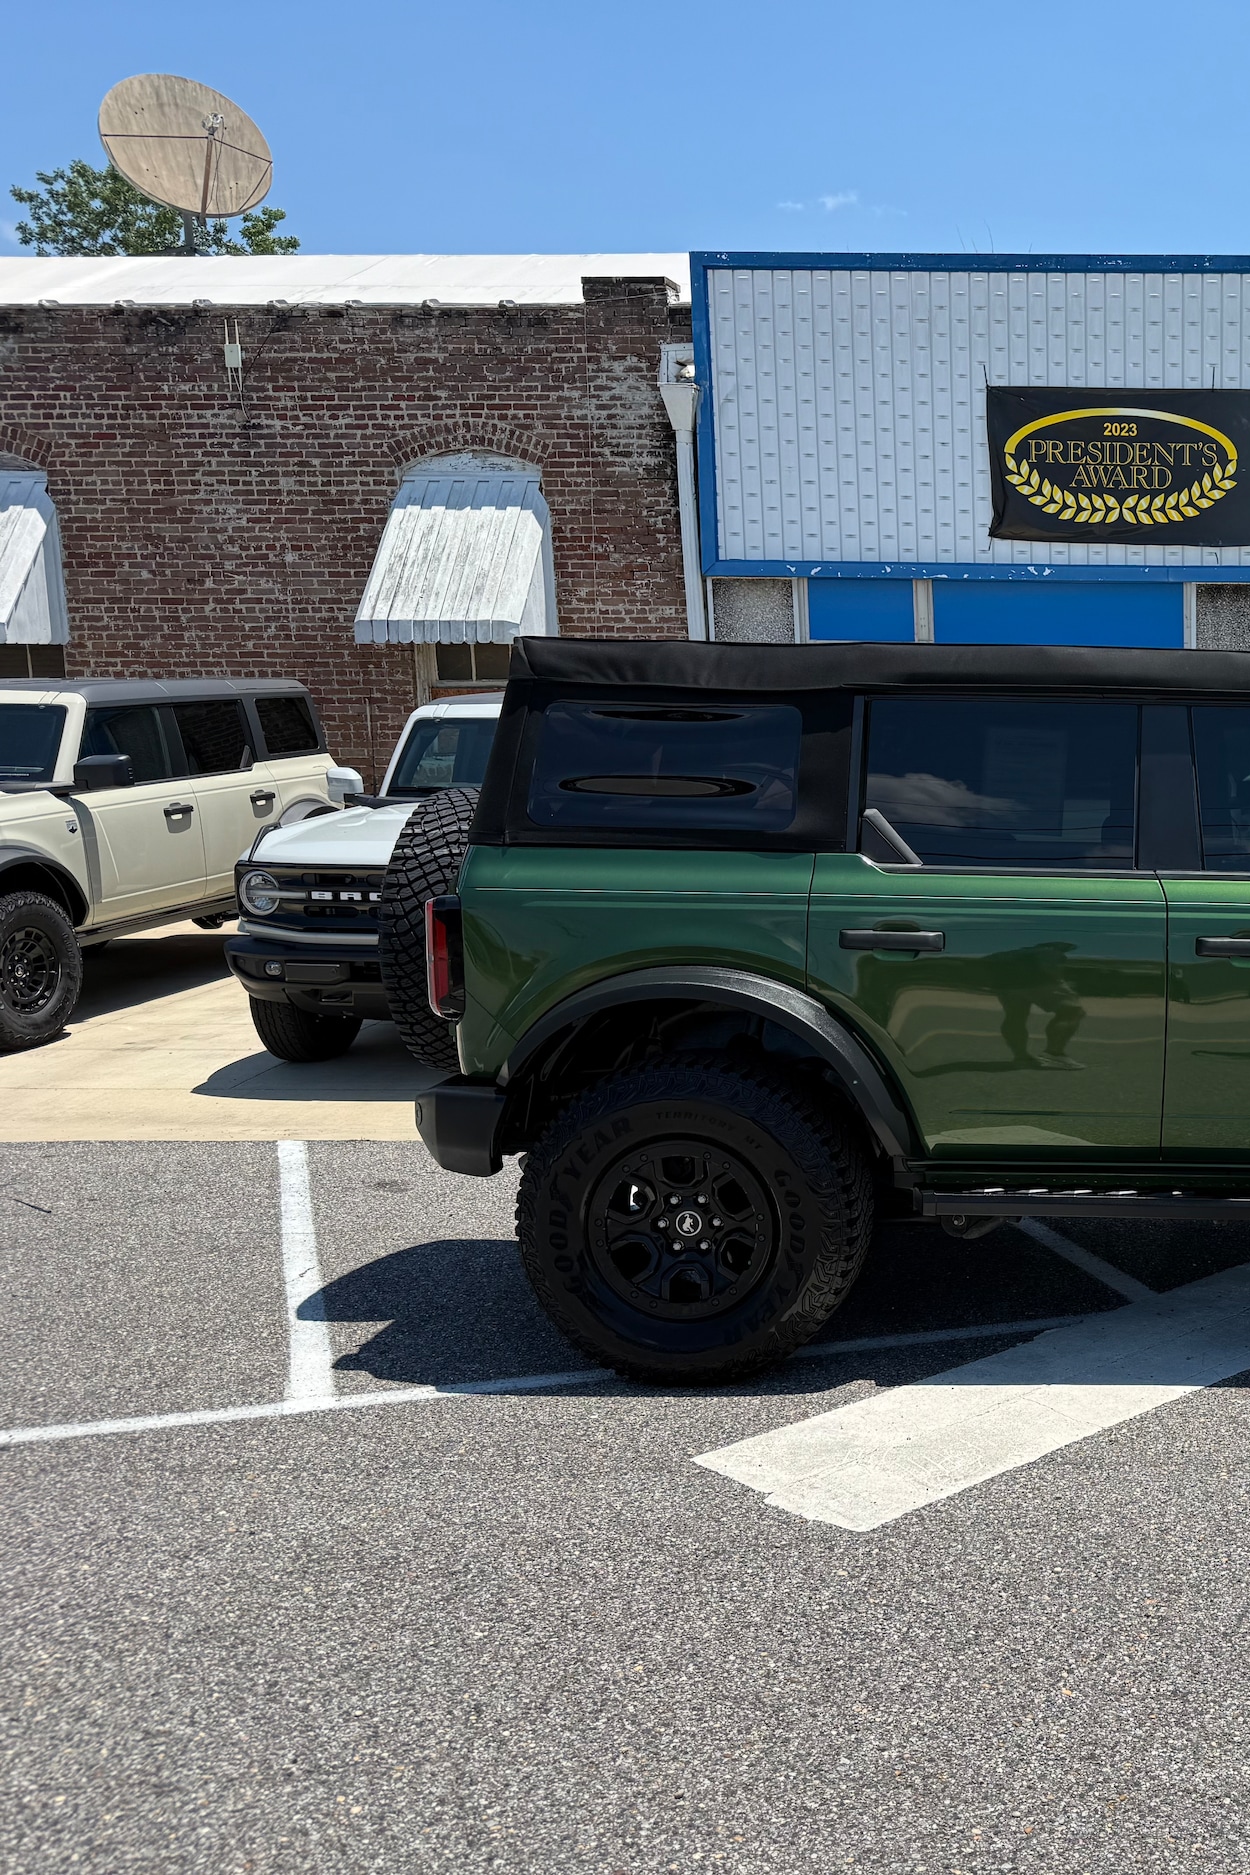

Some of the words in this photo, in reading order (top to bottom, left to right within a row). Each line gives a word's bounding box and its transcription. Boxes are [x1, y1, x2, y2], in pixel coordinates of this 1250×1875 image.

[1103, 422, 1138, 437] 2023
[1027, 439, 1219, 467] PRESIDENT'S
[1069, 464, 1173, 490] AWARD
[656, 1111, 737, 1131] TERRITORY
[548, 1116, 635, 1297] GOODYEAR
